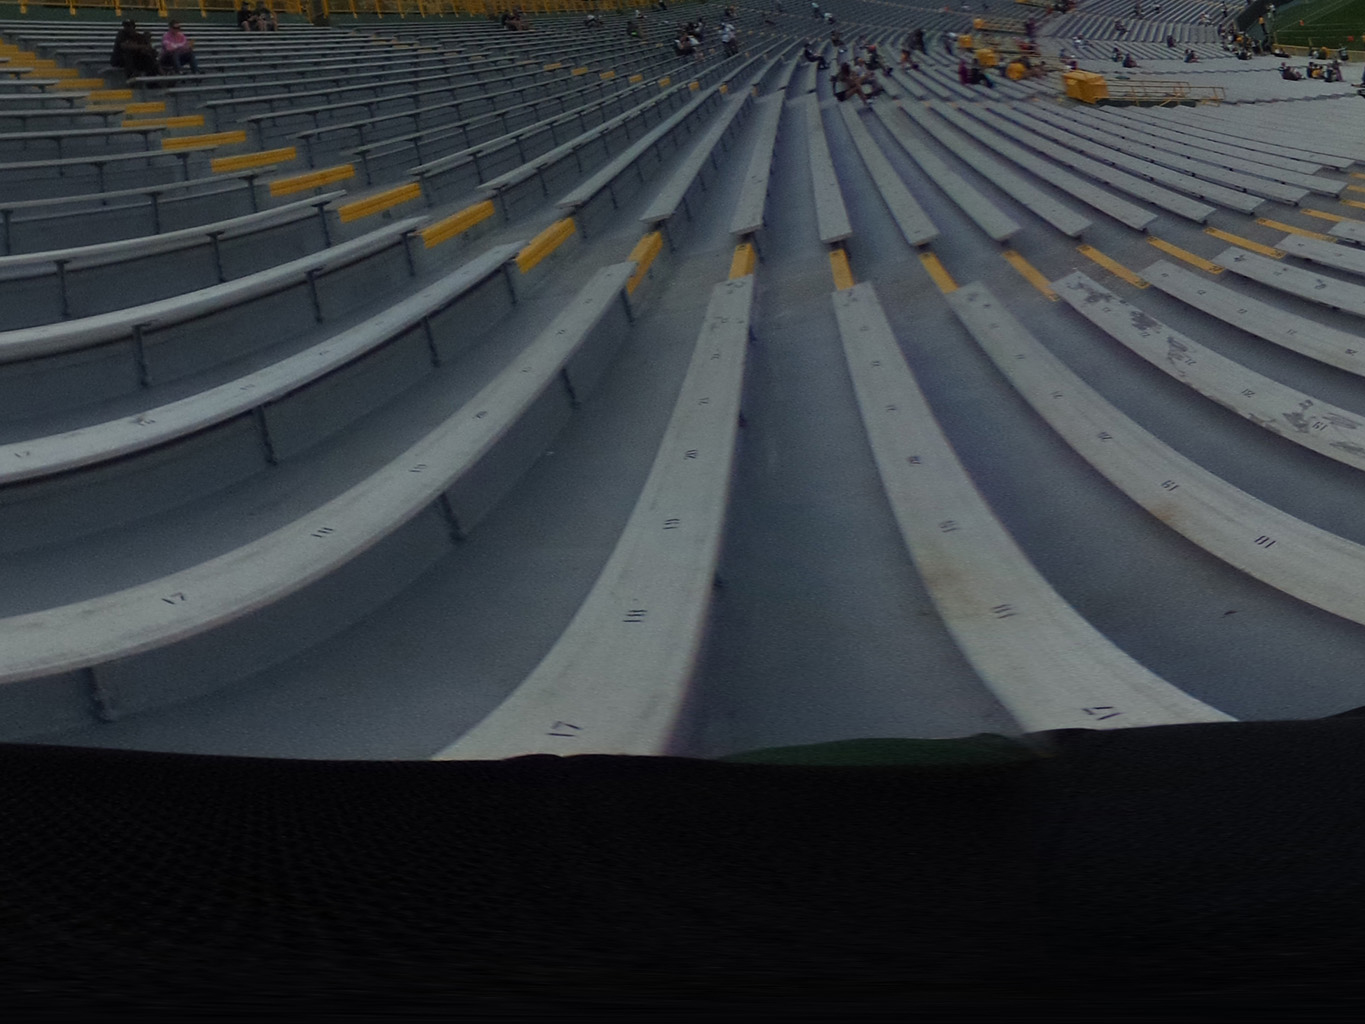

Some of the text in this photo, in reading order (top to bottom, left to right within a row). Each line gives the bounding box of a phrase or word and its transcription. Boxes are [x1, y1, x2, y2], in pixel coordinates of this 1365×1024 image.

[1312, 418, 1332, 431] 19
[162, 593, 185, 605] 17
[1082, 706, 1120, 720] 17
[548, 721, 581, 737] 17
